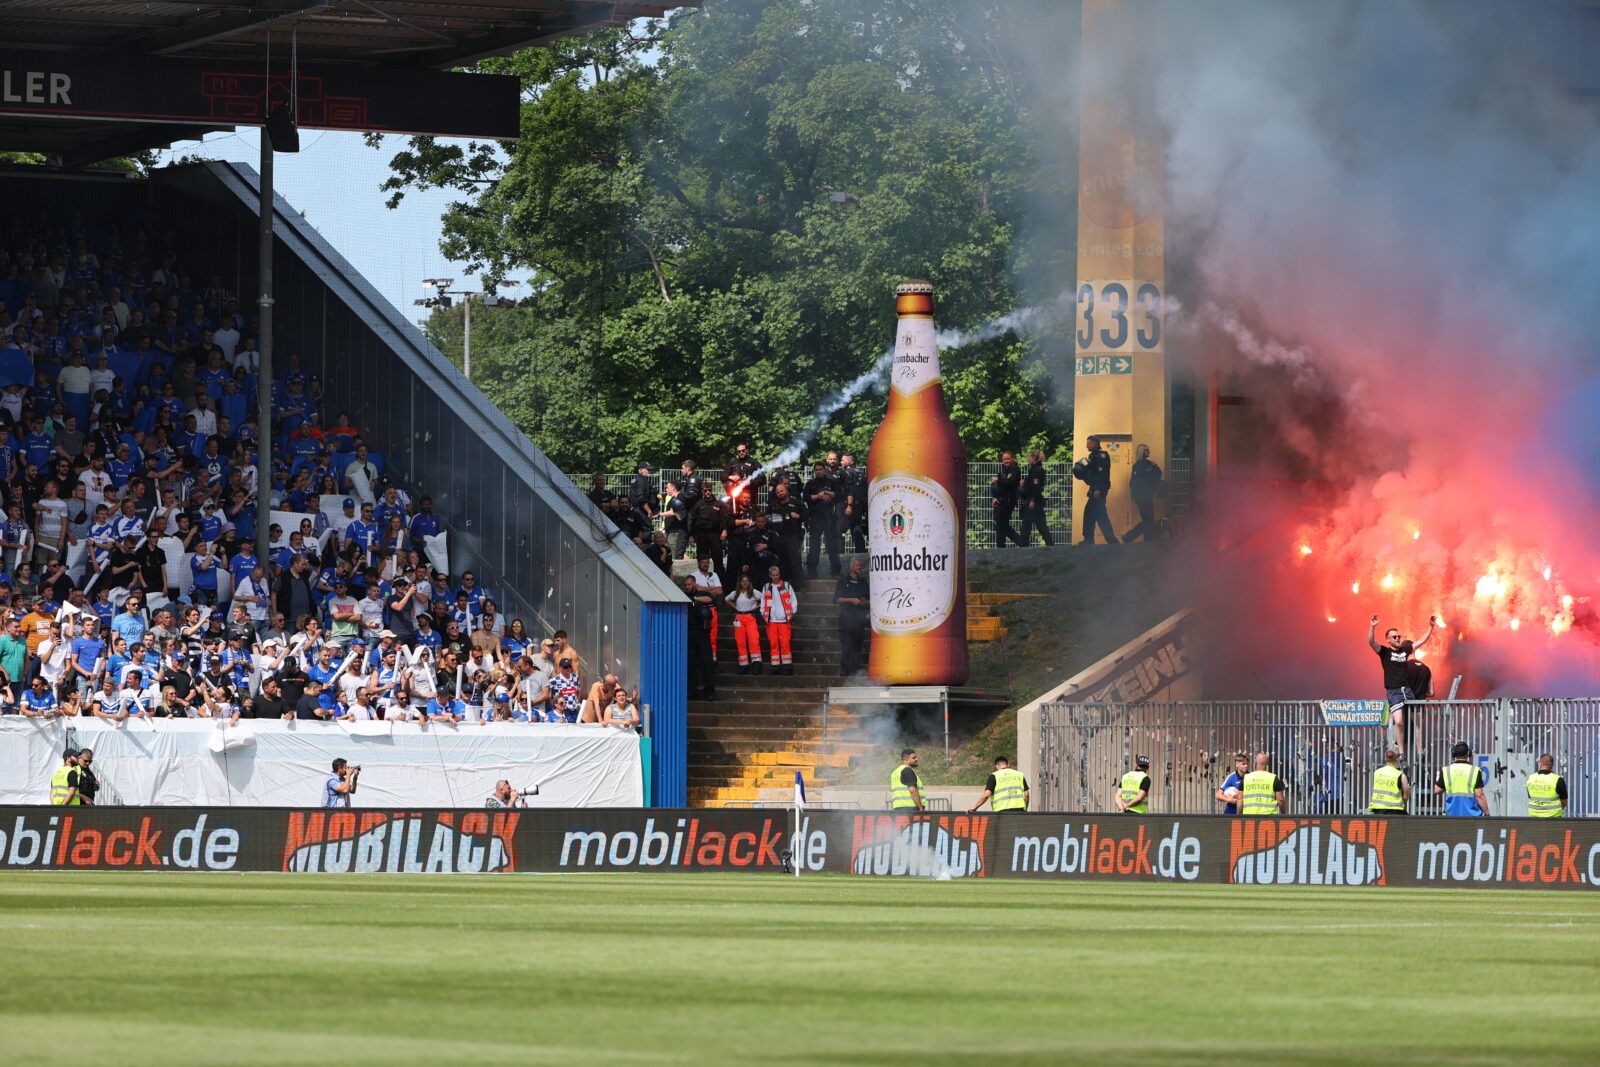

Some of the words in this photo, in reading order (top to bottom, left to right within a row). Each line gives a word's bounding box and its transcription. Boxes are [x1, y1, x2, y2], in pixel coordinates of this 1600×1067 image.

[3, 70, 72, 105] LER
[1077, 282, 1161, 349] 333
[894, 352, 930, 364] rombacher
[898, 366, 918, 379] Pils
[870, 546, 949, 571] rombacher
[880, 587, 915, 612] Pils
[1323, 700, 1356, 711] SCHNAPS
[1357, 701, 1362, 711] &
[1364, 701, 1384, 711] WEED
[0, 814, 240, 870] bilack.de
[282, 811, 521, 873] MOBILACK
[850, 814, 990, 878] MOBILACK
[1011, 822, 1202, 880] mobilack.de
[1228, 819, 1389, 886] MOBILACK
